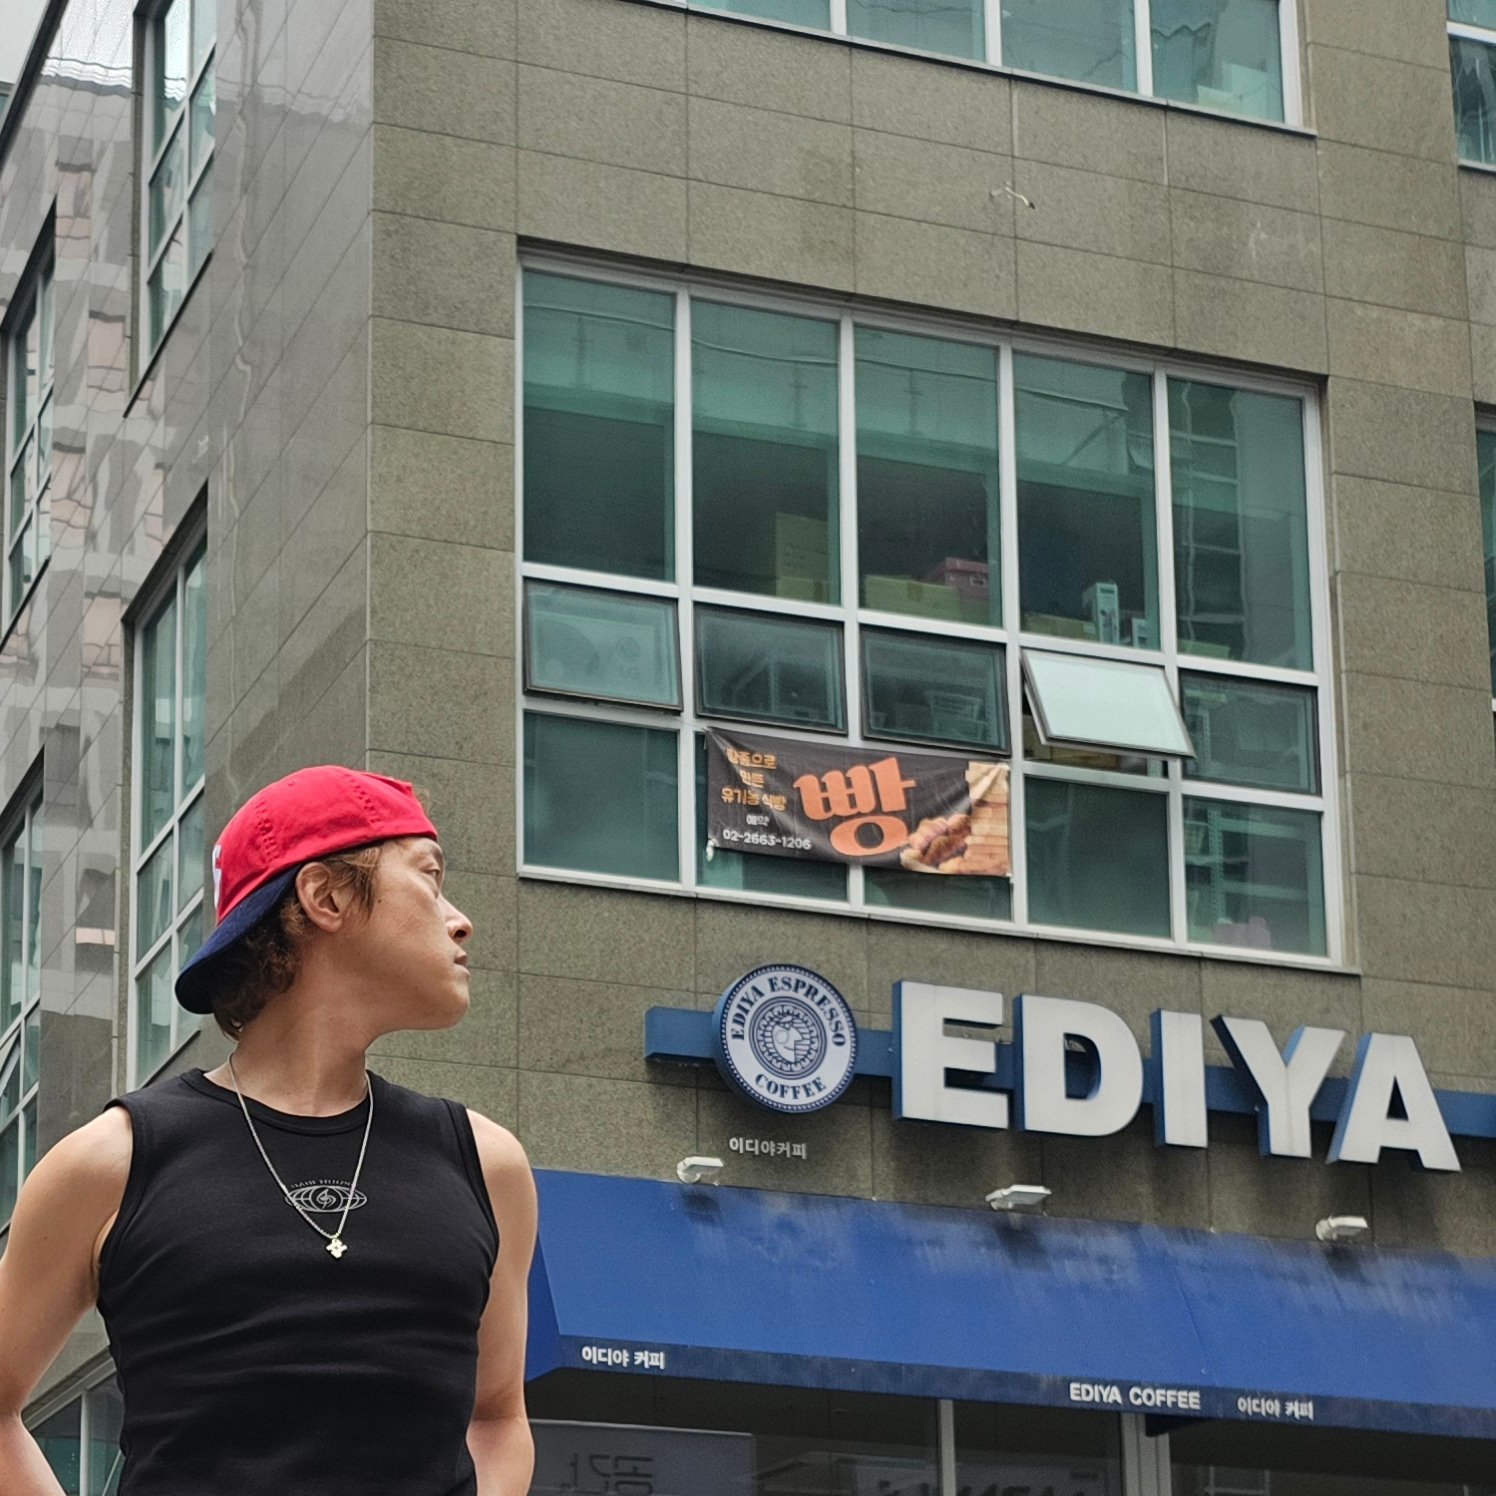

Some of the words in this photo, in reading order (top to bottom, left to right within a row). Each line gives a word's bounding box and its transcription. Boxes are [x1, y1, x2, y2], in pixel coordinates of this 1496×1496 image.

[793, 756, 917, 856] 빵
[731, 985, 765, 1041] EDIYA
[767, 976, 846, 1047] ESPRESSO
[755, 1073, 827, 1100] COFFEE
[894, 980, 1461, 1172] EDIYA
[729, 1137, 807, 1159] 이디야커피
[582, 1346, 629, 1367] 이디야
[634, 1350, 665, 1370] 커피
[1069, 1382, 1122, 1404] EDIYA
[1129, 1387, 1201, 1410] COFFEE
[1237, 1396, 1280, 1418] 이디야
[1285, 1400, 1314, 1421] 커피
